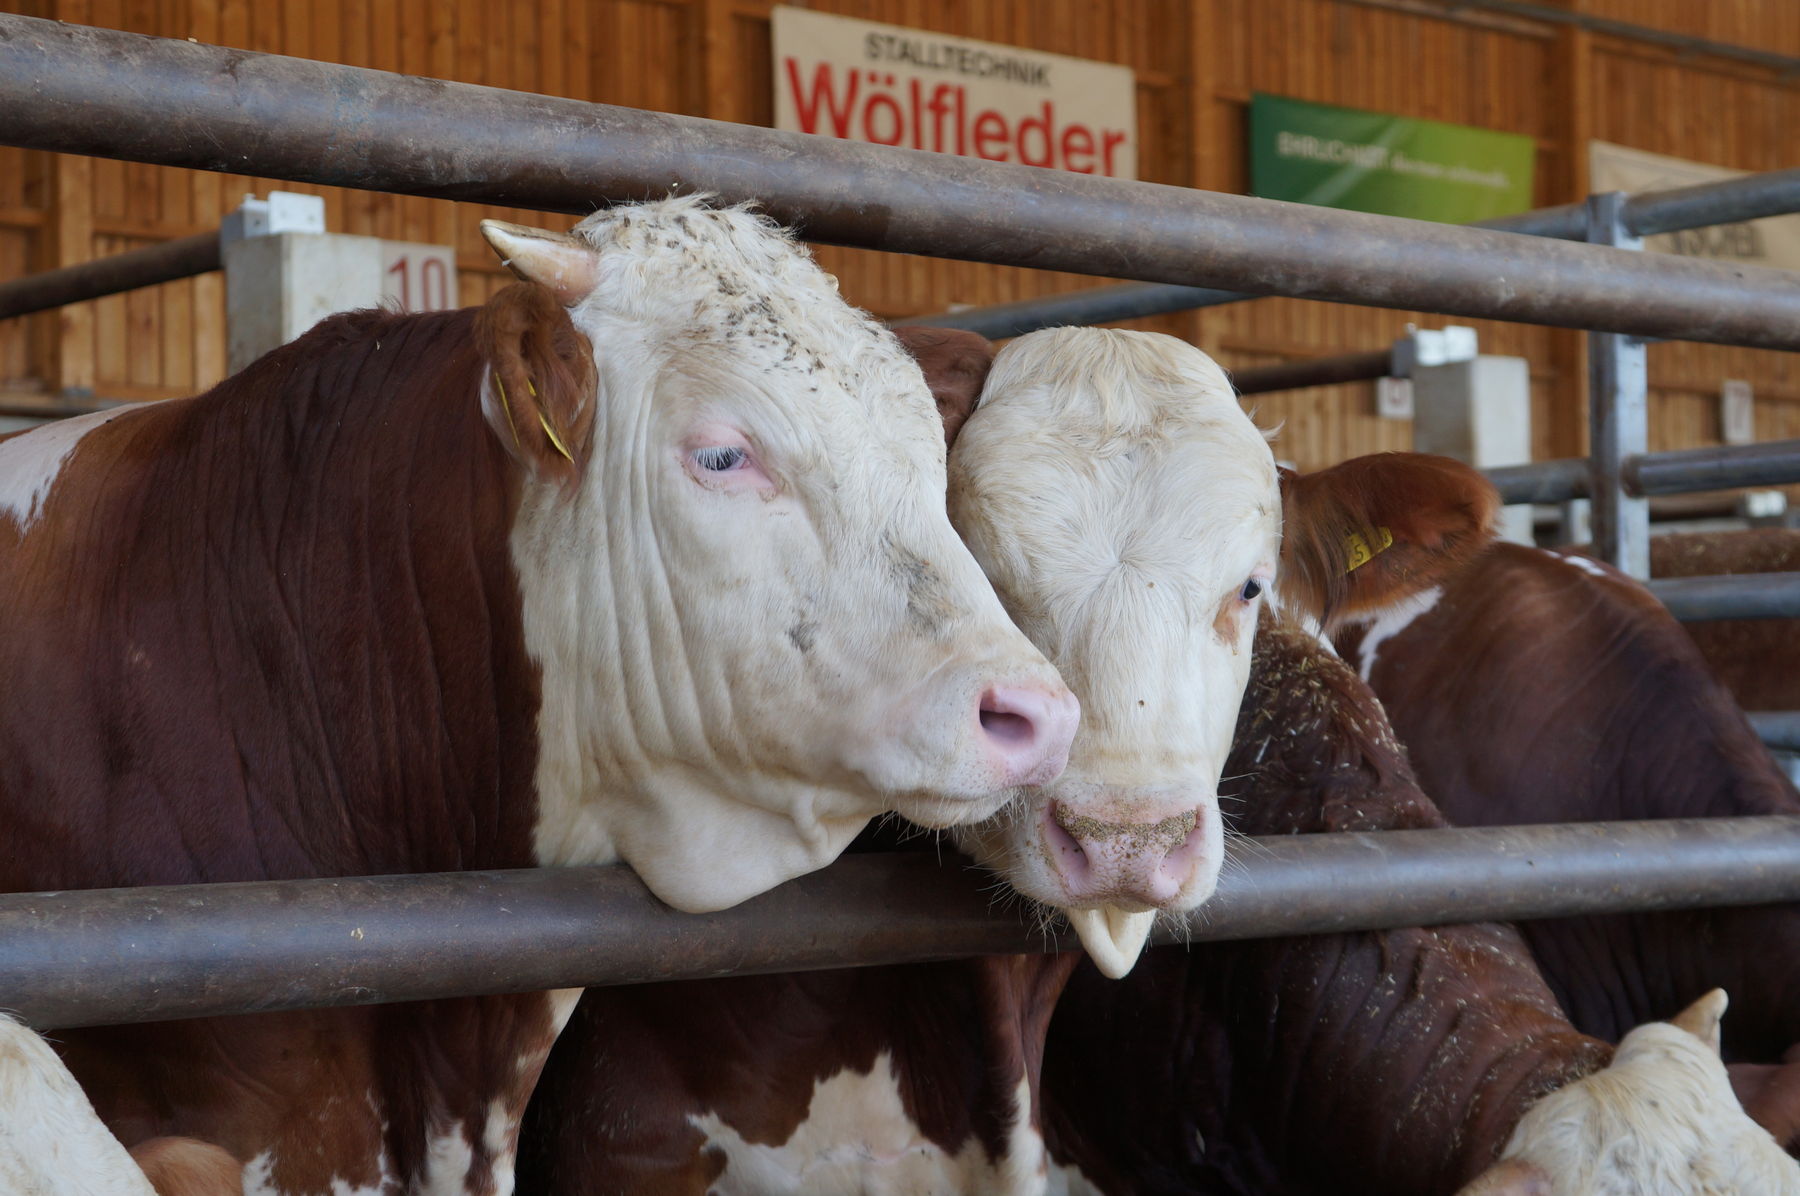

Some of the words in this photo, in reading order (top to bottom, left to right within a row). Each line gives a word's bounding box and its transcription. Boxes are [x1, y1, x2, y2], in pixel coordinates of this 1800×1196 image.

[865, 32, 1051, 87] STALLTECHNIK
[785, 57, 1126, 177] Wölfleder
[388, 256, 448, 313] 10
